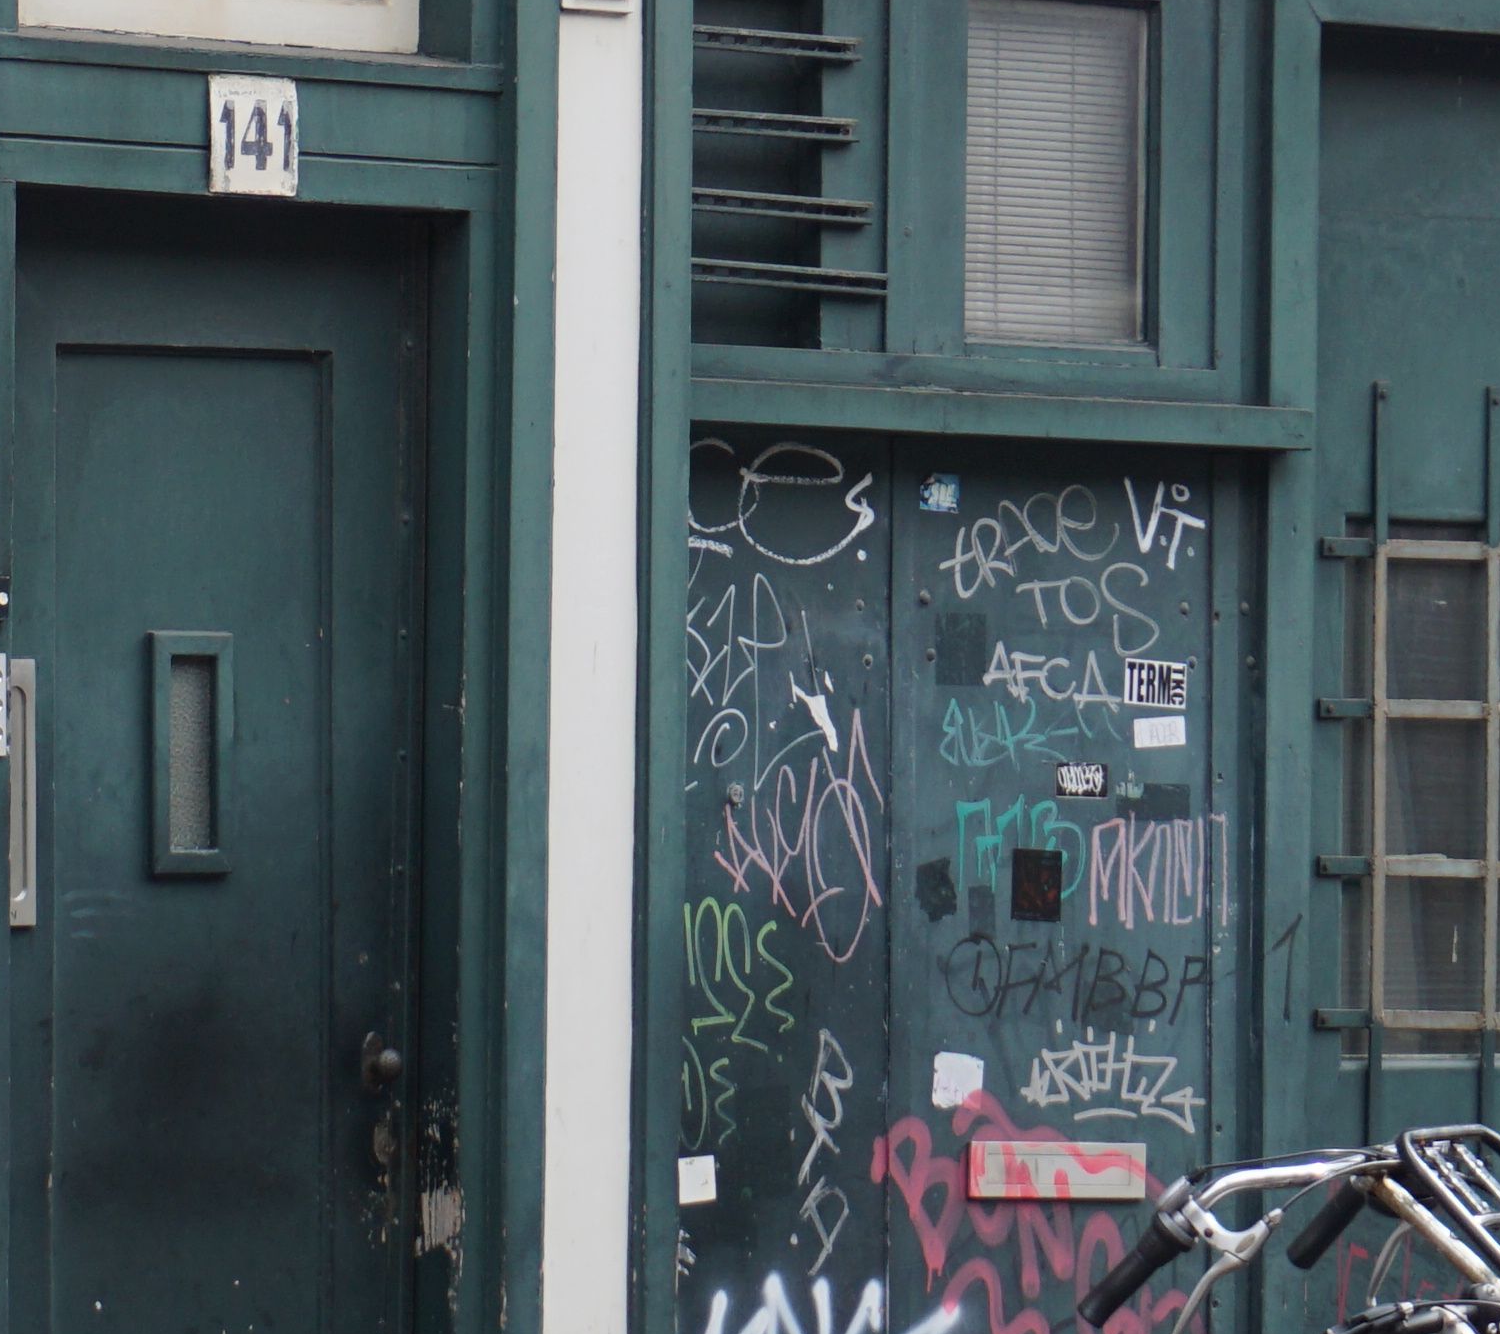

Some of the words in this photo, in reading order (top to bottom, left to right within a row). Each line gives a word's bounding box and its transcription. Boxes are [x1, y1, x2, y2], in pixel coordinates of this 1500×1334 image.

[219, 99, 292, 172] 141
[982, 641, 1122, 713] AFCA
[1126, 661, 1171, 705] TERM
